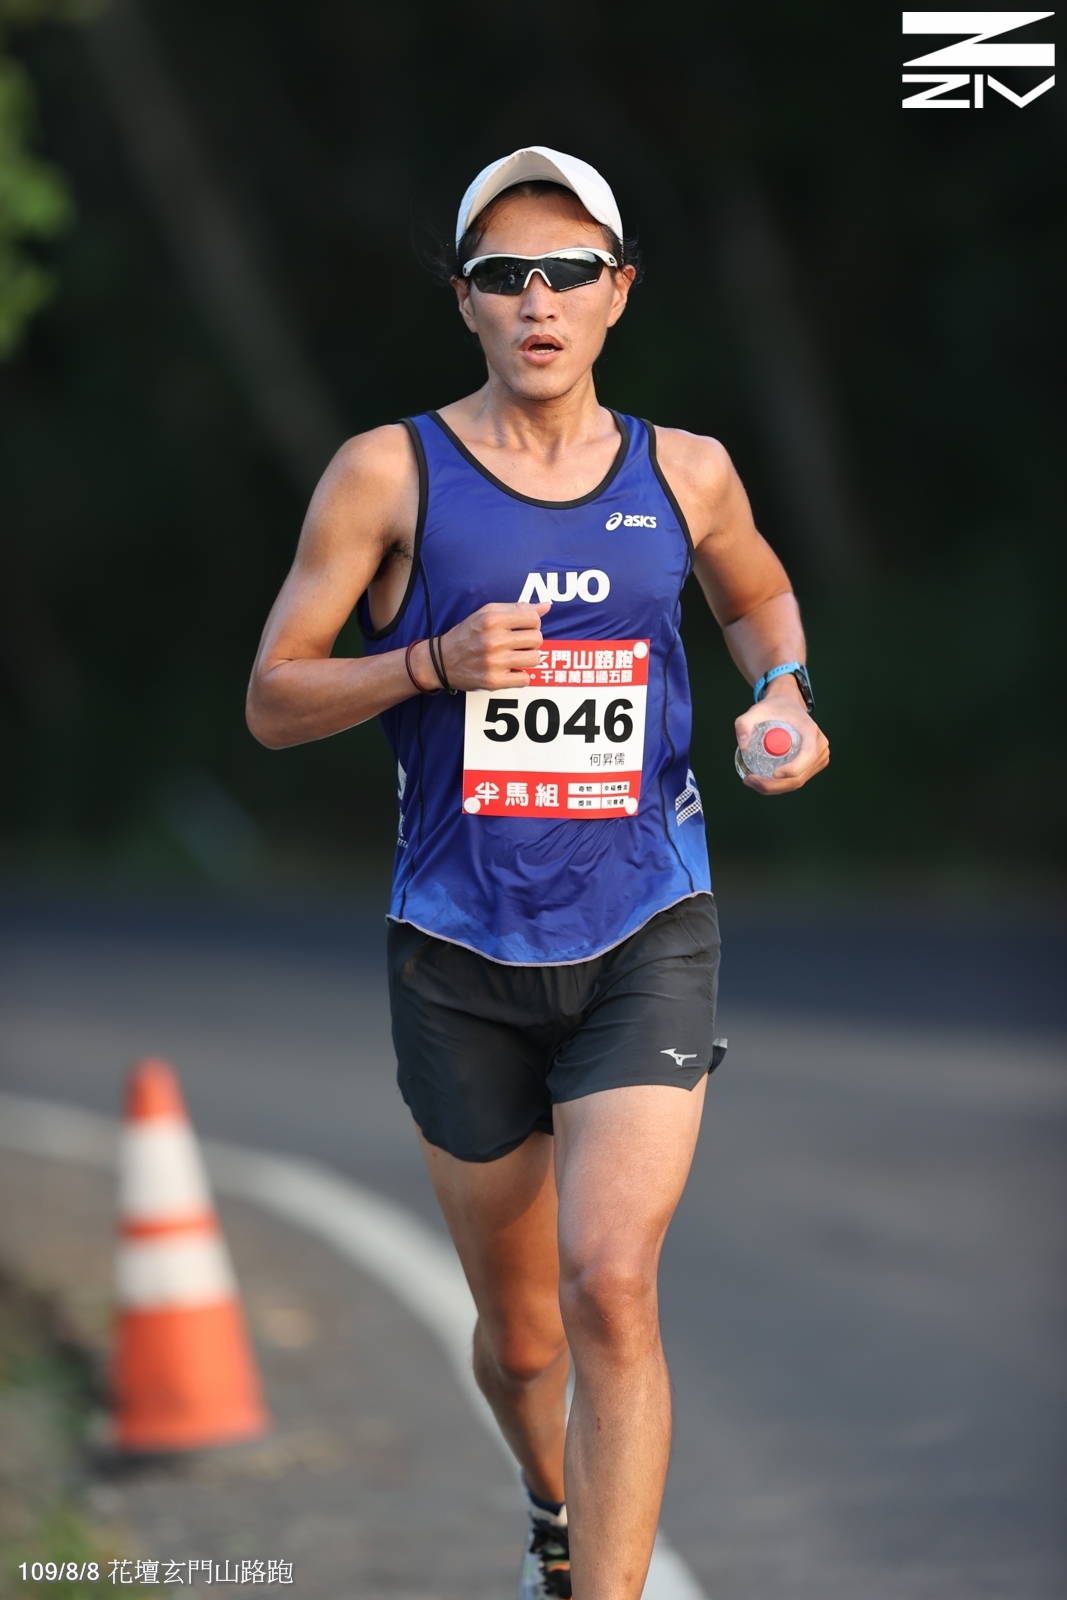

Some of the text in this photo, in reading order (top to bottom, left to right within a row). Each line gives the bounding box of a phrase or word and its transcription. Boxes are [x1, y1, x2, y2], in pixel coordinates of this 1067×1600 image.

[623, 514, 657, 528] asics
[518, 569, 610, 604] AUO
[483, 698, 633, 743] 5046
[590, 753, 625, 766] 何昇儒
[474, 781, 560, 808] 半馬組
